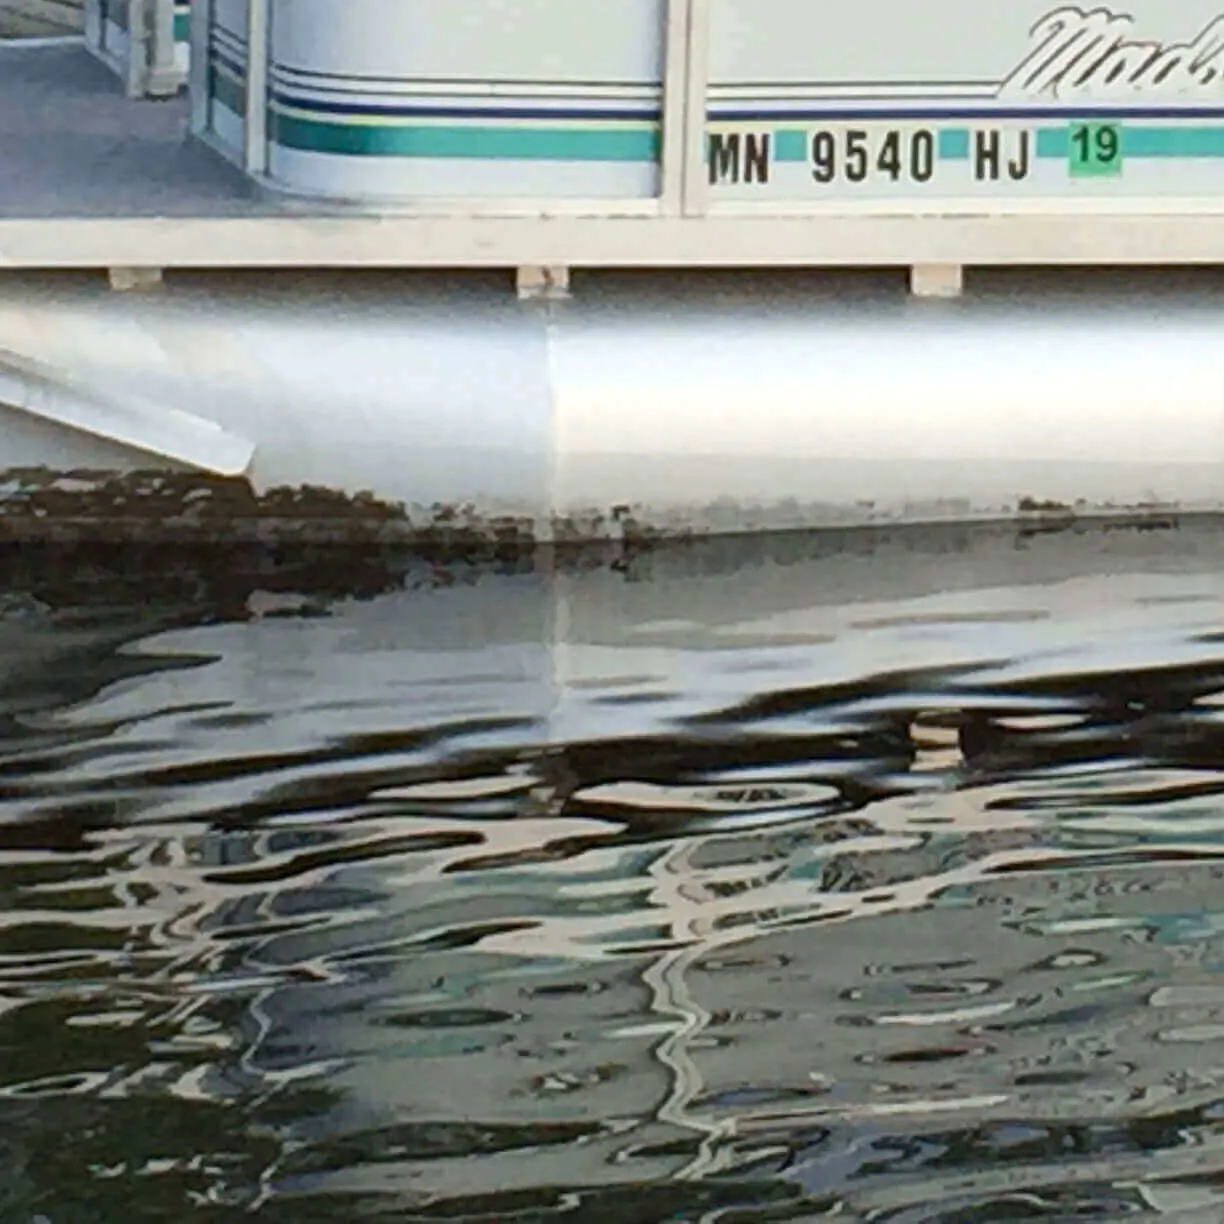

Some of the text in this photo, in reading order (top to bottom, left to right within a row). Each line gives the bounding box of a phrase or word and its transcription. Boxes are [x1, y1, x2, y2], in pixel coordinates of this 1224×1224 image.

[708, 128, 1030, 184] MN 9540 HJ
[1071, 124, 1119, 163] 19
